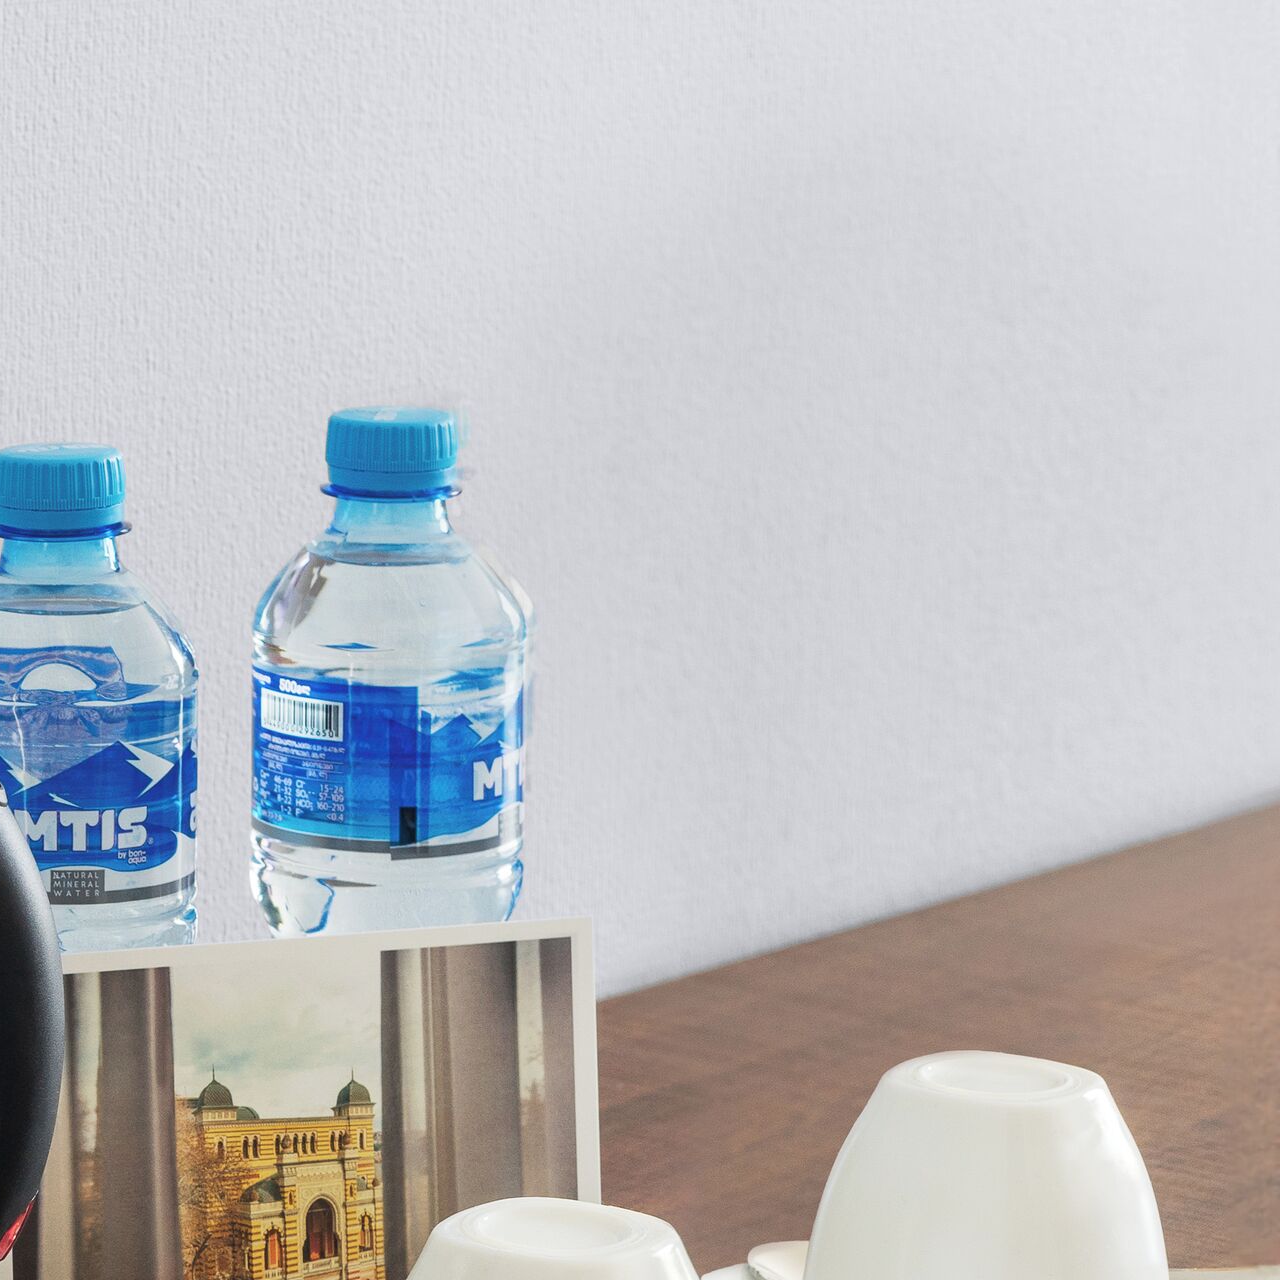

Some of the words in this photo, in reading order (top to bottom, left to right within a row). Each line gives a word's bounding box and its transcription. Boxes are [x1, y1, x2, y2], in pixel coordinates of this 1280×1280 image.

[52, 871, 100, 880] NATURAL
[53, 880, 100, 889] MINERAL
[53, 889, 101, 897] WATER
